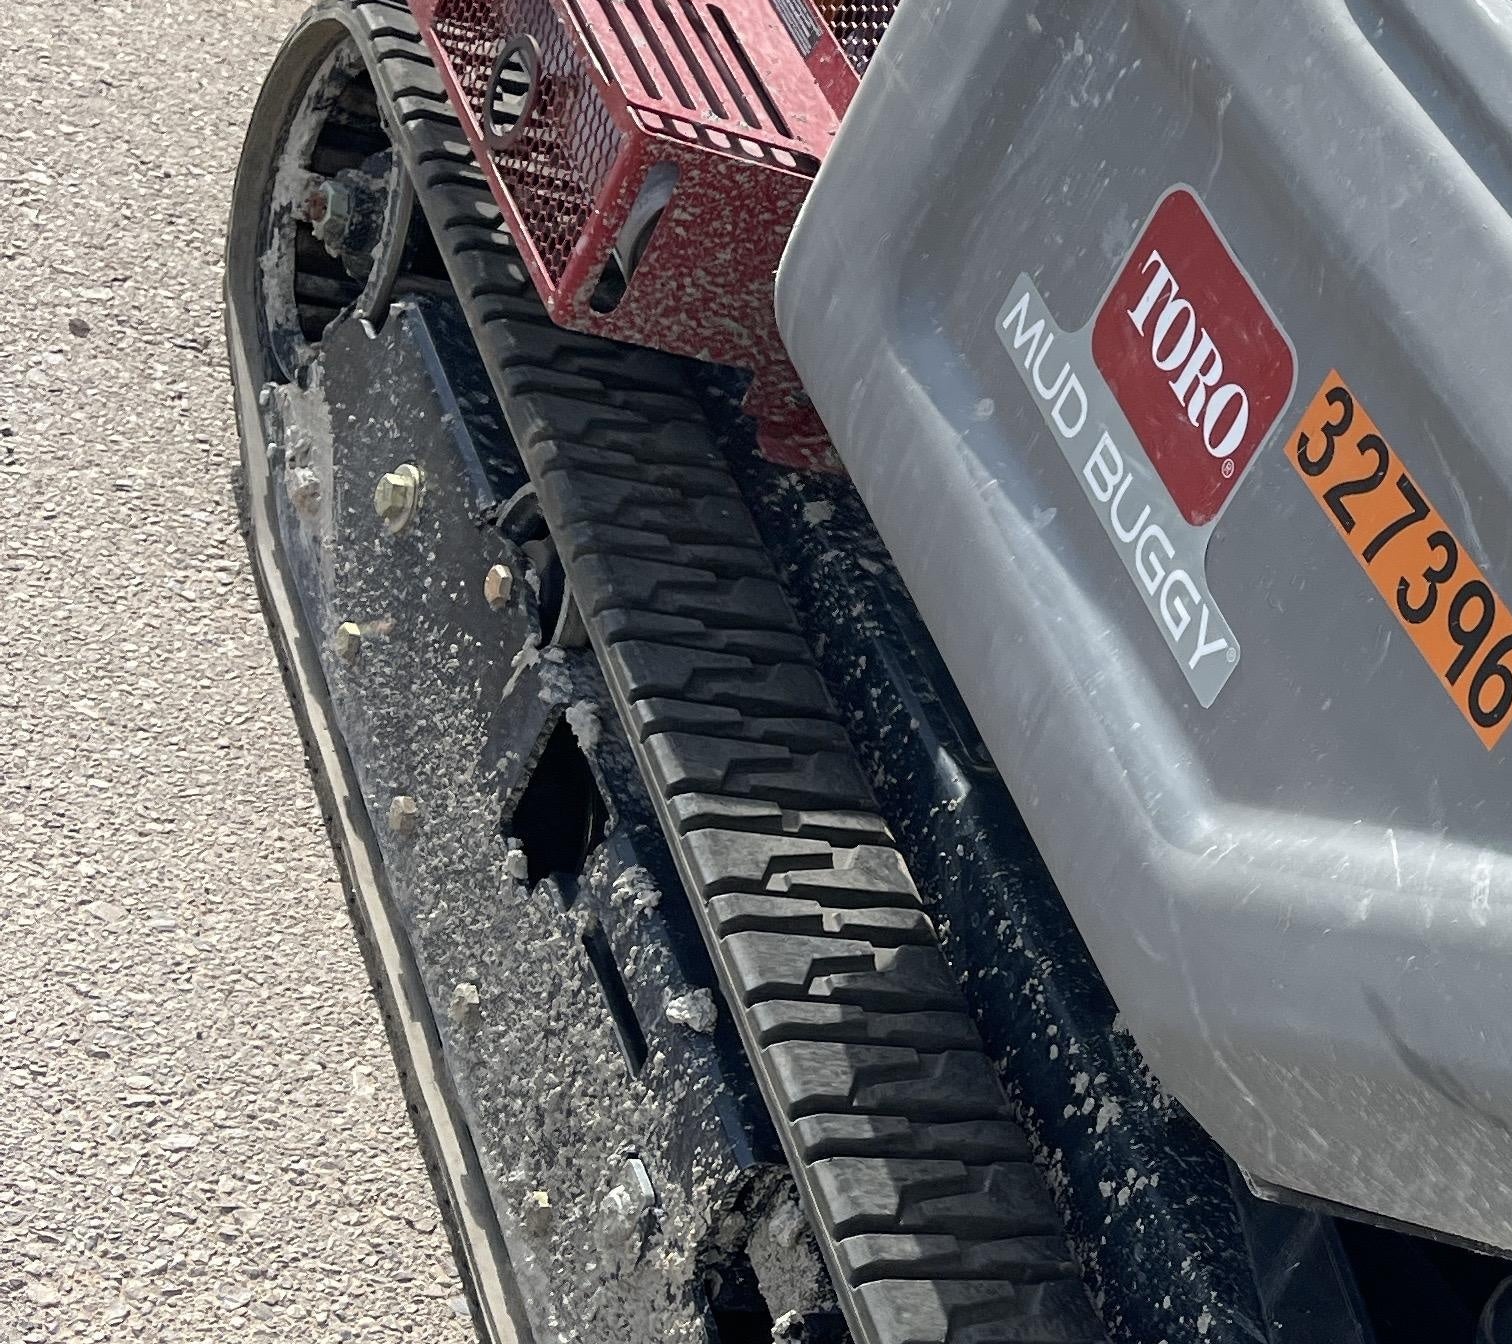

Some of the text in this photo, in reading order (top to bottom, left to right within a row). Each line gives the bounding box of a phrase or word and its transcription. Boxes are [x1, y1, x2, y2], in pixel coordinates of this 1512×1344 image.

[1003, 292, 1228, 670] MUD BUGGY
[1126, 250, 1250, 459] TORO
